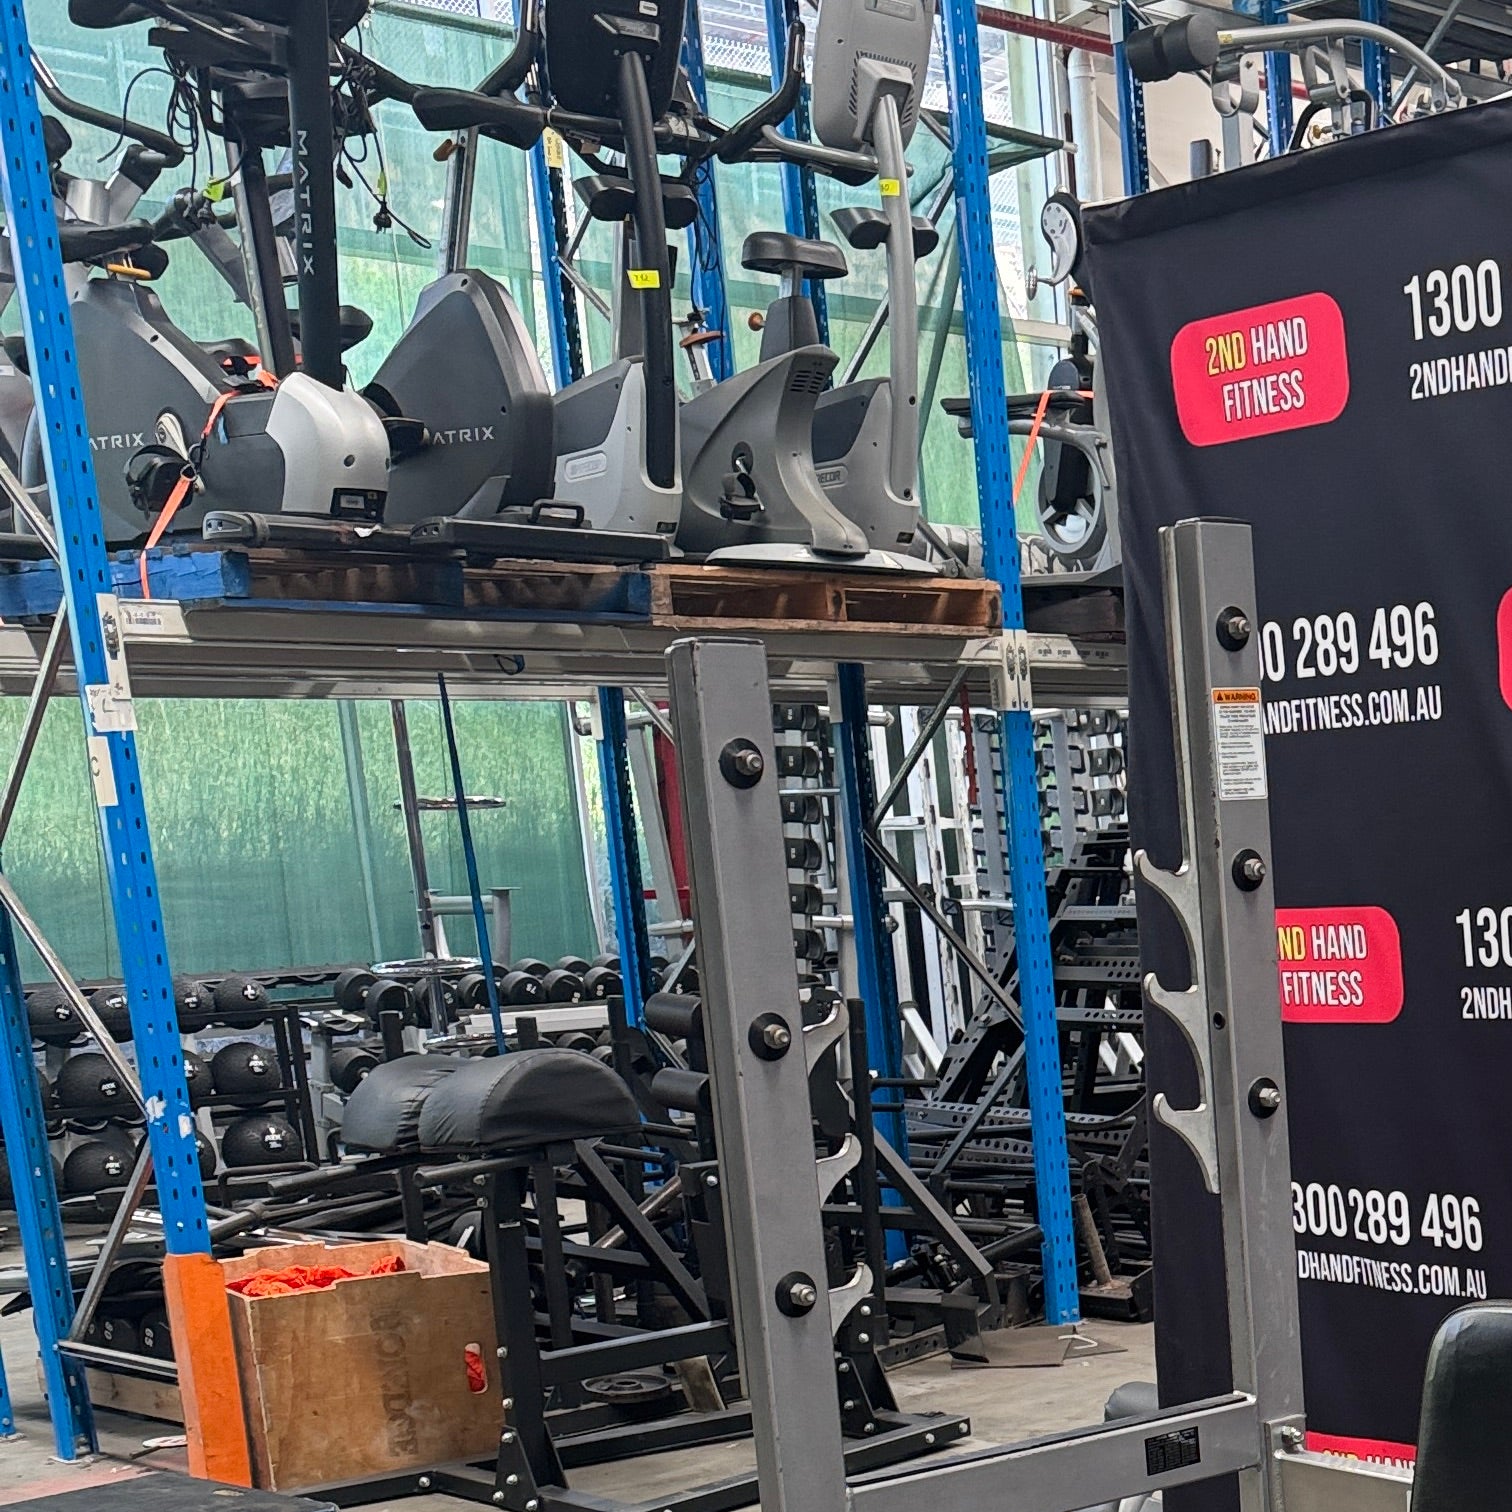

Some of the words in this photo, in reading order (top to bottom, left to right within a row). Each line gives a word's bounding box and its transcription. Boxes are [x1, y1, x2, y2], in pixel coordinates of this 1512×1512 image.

[297, 130, 315, 276] MATRIX
[1403, 259, 1503, 341] 1300
[1205, 331, 1246, 376] 2ND
[1250, 317, 1308, 365] HAND
[1222, 369, 1305, 422] FITNESS
[88, 432, 145, 450] ATRIX
[432, 425, 495, 445] ATRIX
[1292, 611, 1360, 679] 289
[1368, 601, 1439, 670] 496
[1263, 684, 1443, 736] NDFITNESS.COM.AU
[1278, 927, 1306, 961] ND
[1311, 924, 1367, 960] HAND
[1282, 970, 1364, 1006] FITNESS
[1290, 1181, 1348, 1238] 300
[1347, 1188, 1411, 1246] 289
[1420, 1193, 1483, 1252] 496
[1298, 1249, 1491, 1305] DHANDFITNESS.COM.AU
